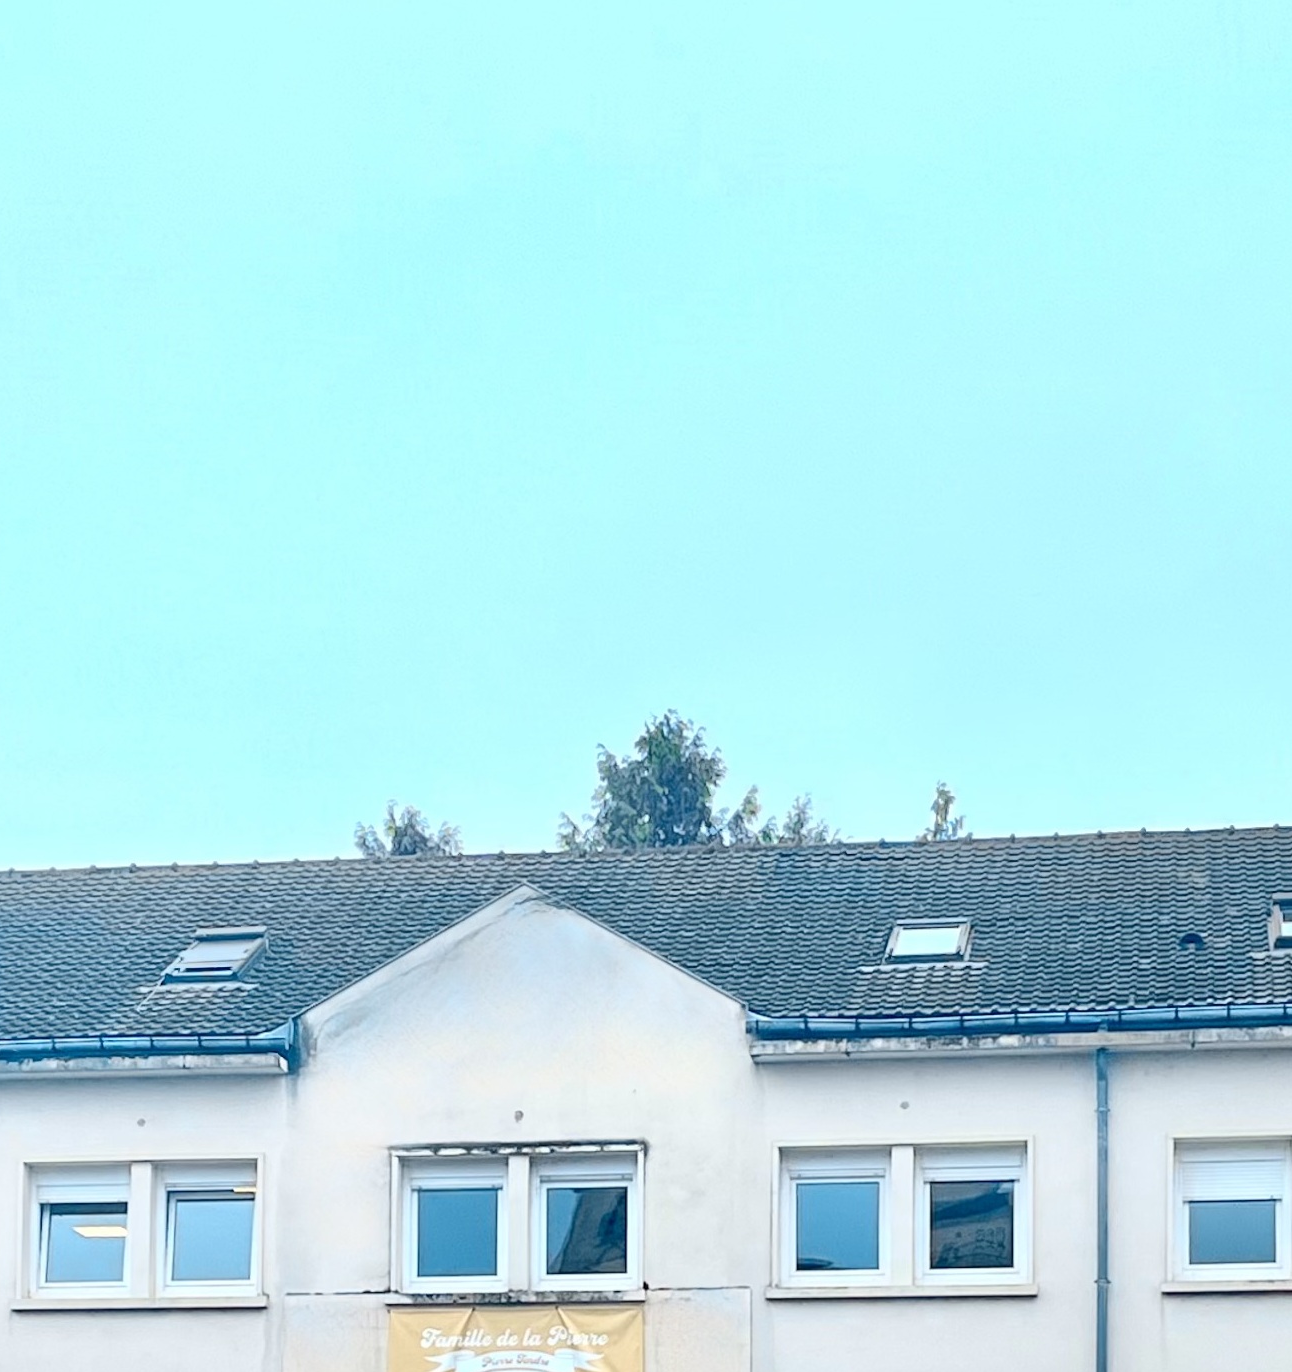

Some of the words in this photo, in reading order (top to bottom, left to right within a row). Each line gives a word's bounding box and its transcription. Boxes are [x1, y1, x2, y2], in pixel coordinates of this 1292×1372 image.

[420, 1327, 492, 1349] Famille
[496, 1328, 519, 1348] de
[522, 1327, 543, 1347] la
